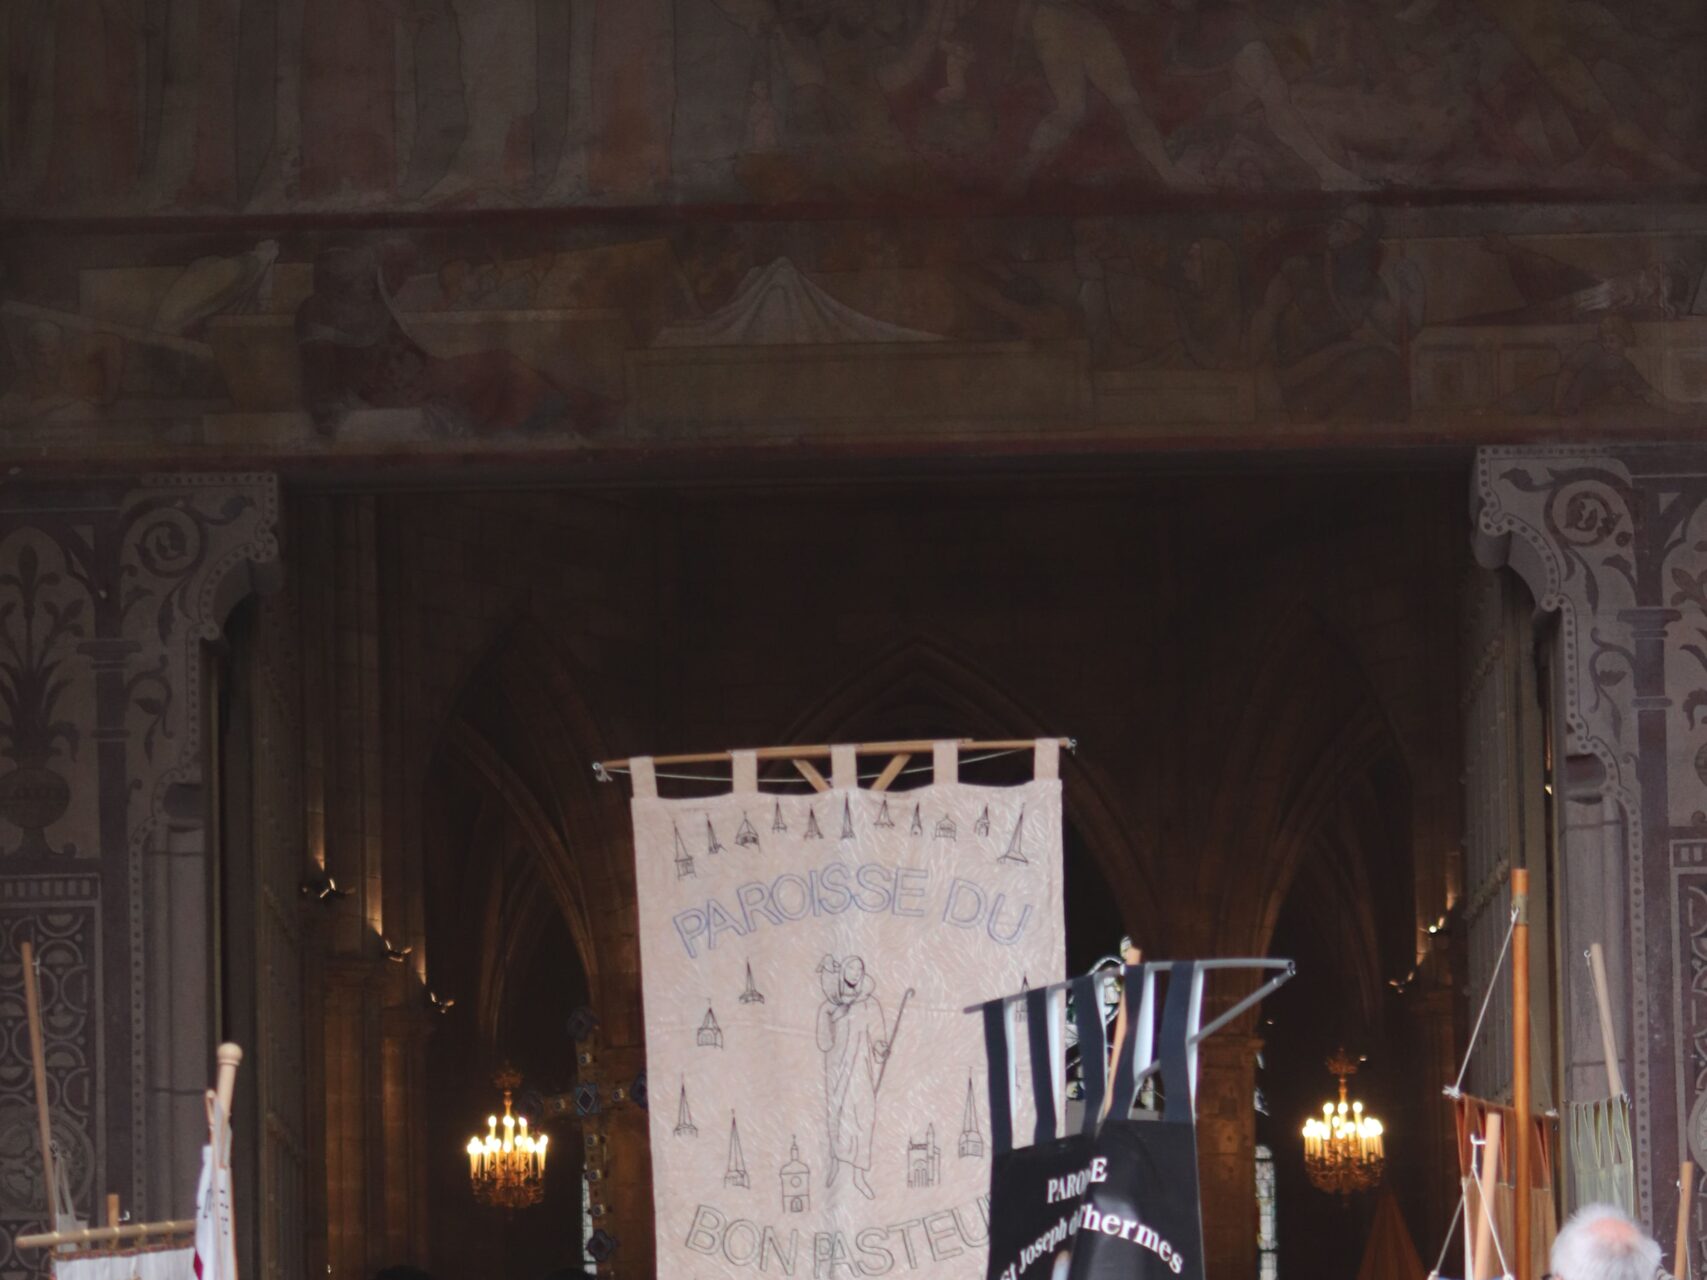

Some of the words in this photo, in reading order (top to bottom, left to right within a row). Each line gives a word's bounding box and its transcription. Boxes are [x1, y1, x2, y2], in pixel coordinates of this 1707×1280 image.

[673, 863, 929, 959] PAROISSE
[942, 878, 1033, 946] DU
[684, 1204, 799, 1277] BON
[813, 1193, 991, 1280] PASTEU
[1019, 1217, 1068, 1274] Joseph
